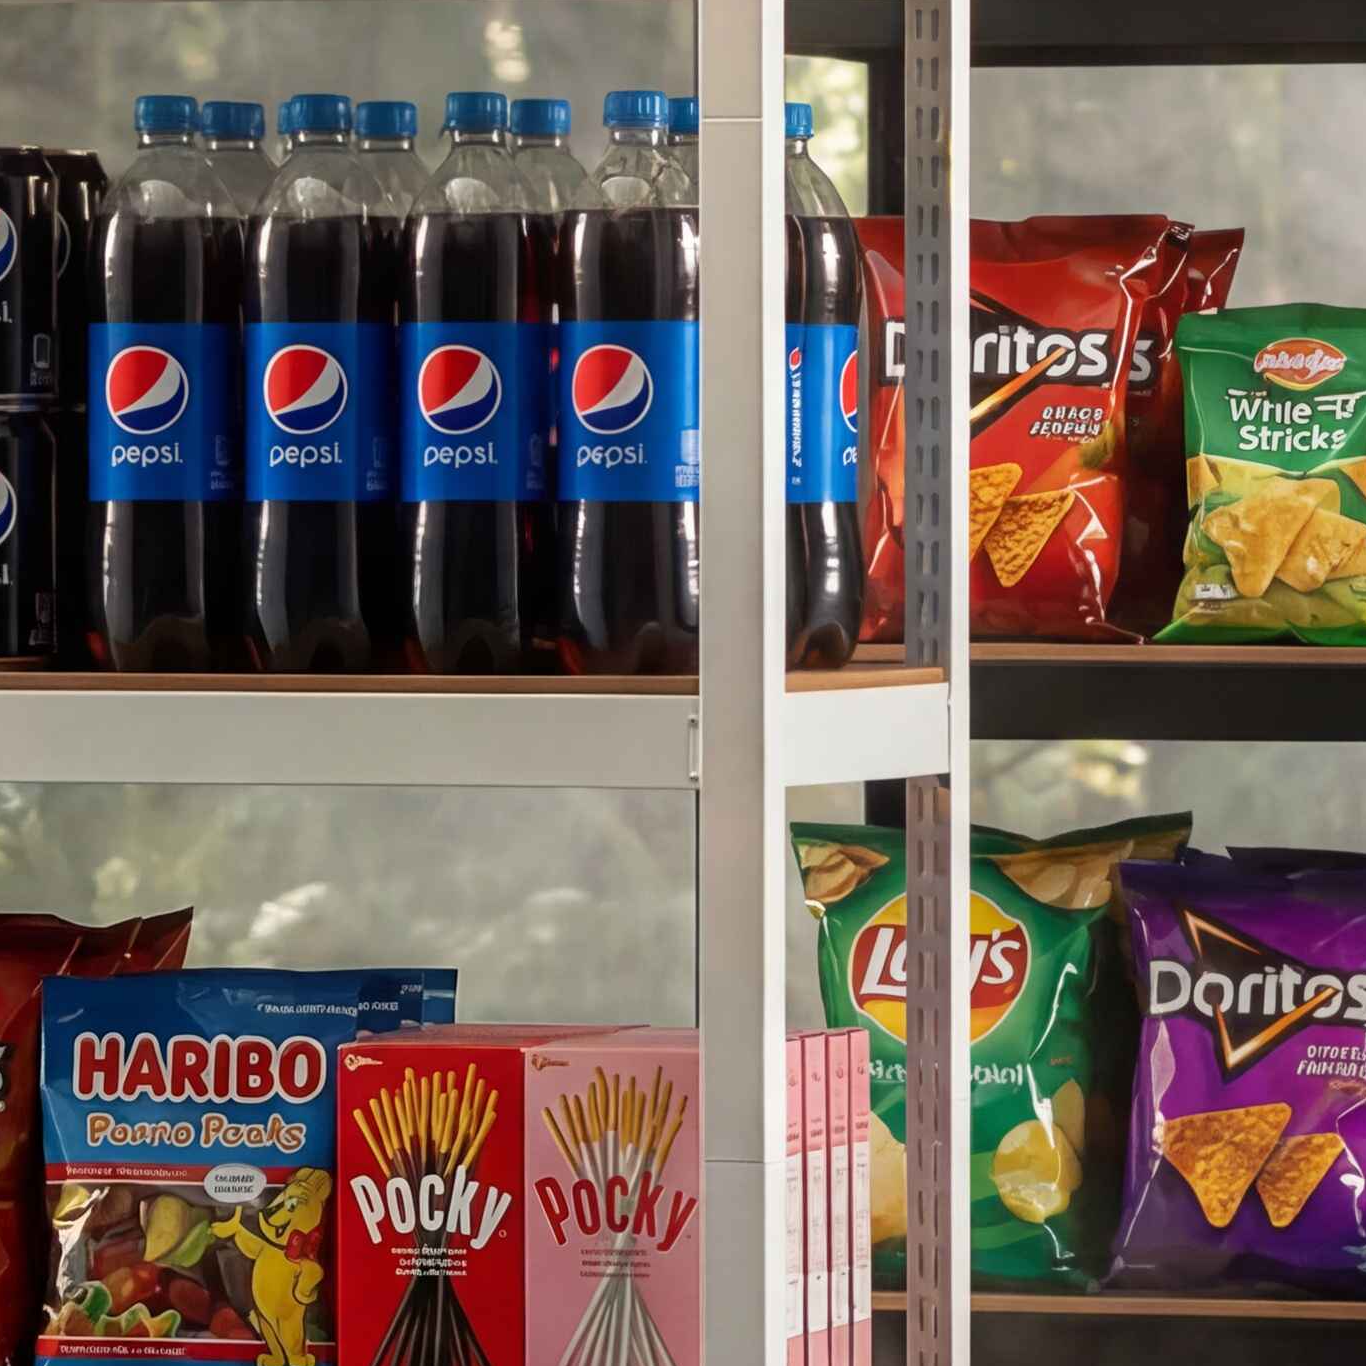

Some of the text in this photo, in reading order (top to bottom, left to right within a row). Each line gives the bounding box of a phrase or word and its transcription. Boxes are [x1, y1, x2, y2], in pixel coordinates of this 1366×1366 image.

[111, 442, 183, 467] pepsi
[269, 442, 342, 467] pepsi
[424, 442, 498, 467] pepsi
[577, 442, 647, 467] pepsi
[72, 1032, 328, 1104] HARIBO
